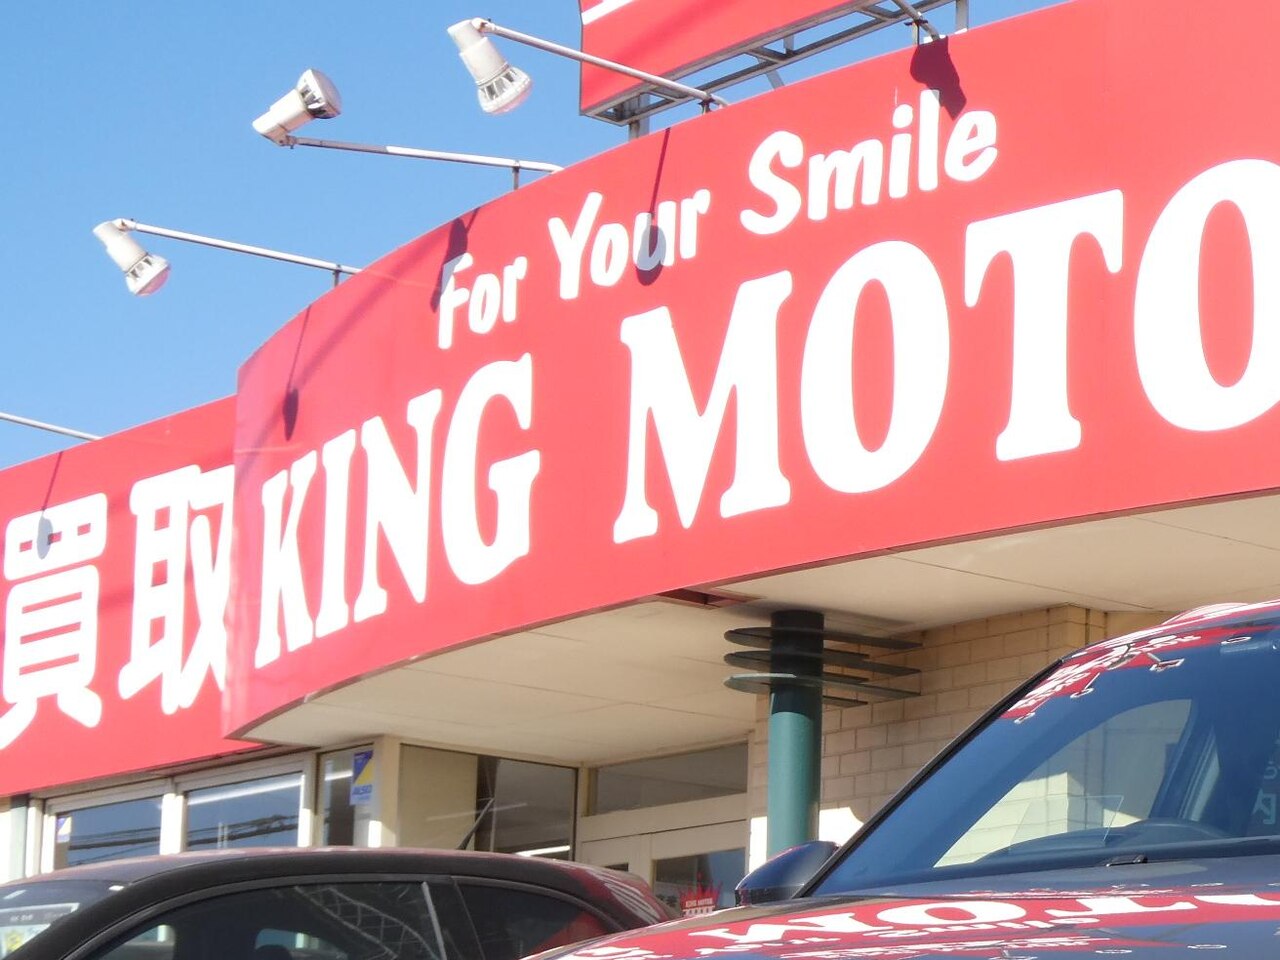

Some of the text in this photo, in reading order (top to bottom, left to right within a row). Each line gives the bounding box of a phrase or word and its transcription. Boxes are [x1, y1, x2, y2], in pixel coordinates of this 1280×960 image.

[437, 89, 998, 350] For Your Smile
[0, 463, 236, 750] 買取
[255, 353, 541, 669] KING
